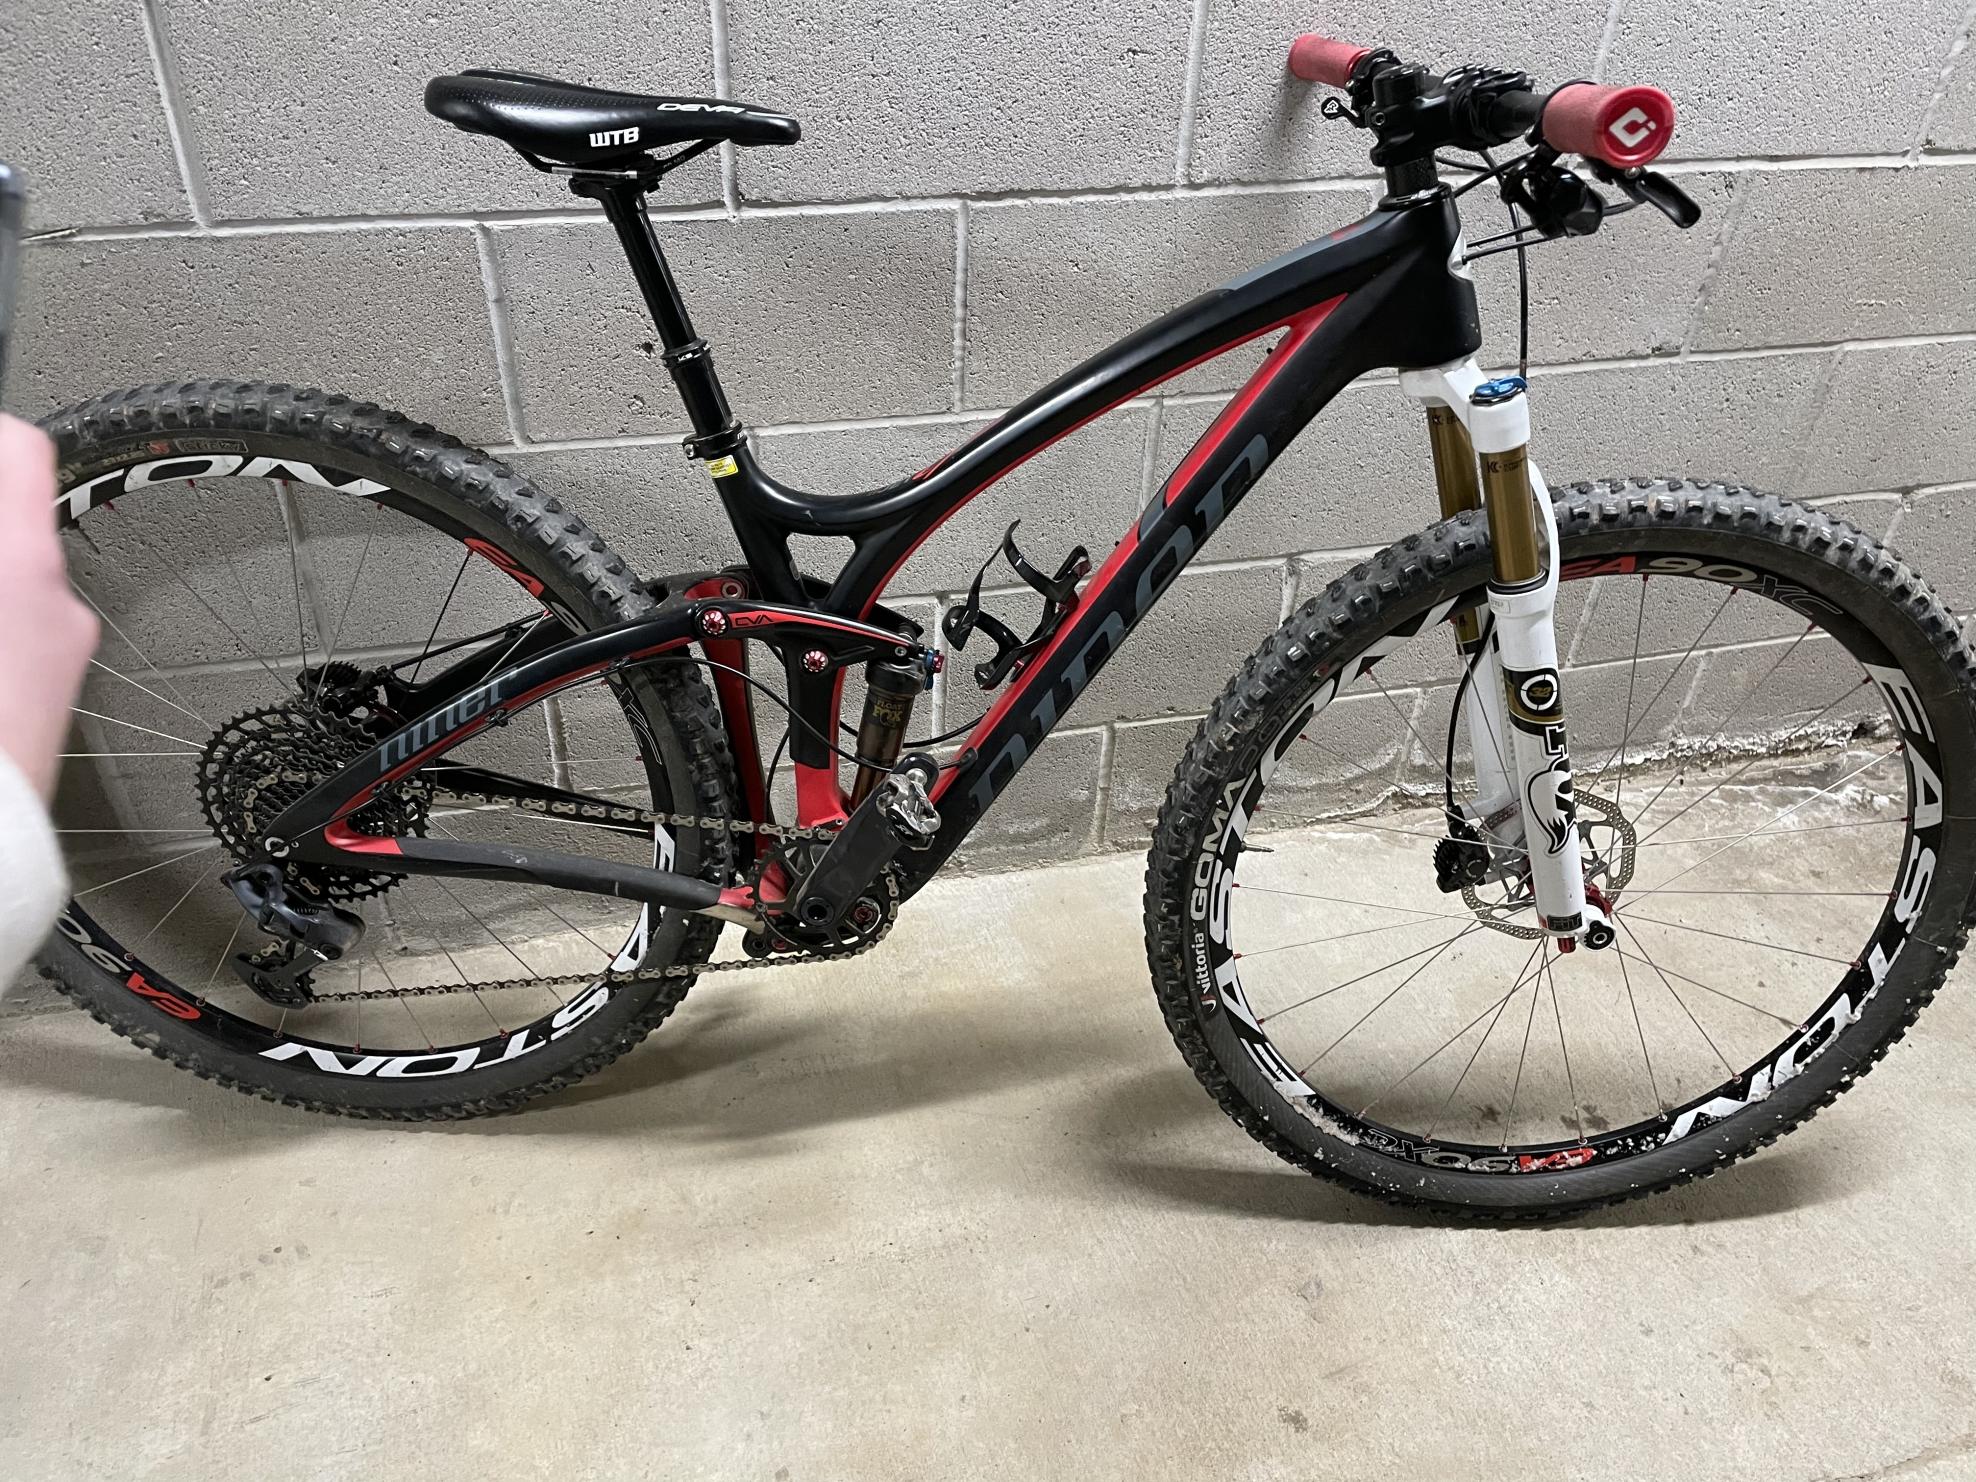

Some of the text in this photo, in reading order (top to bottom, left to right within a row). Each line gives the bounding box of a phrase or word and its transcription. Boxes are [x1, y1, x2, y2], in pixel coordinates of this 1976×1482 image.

[589, 127, 640, 147] WTB
[378, 665, 519, 772] niner
[968, 433, 1269, 815] niner
[1190, 777, 1246, 921] GOMA
[1210, 592, 1459, 1096] EASTON
[1661, 662, 1943, 1146] EASTON
